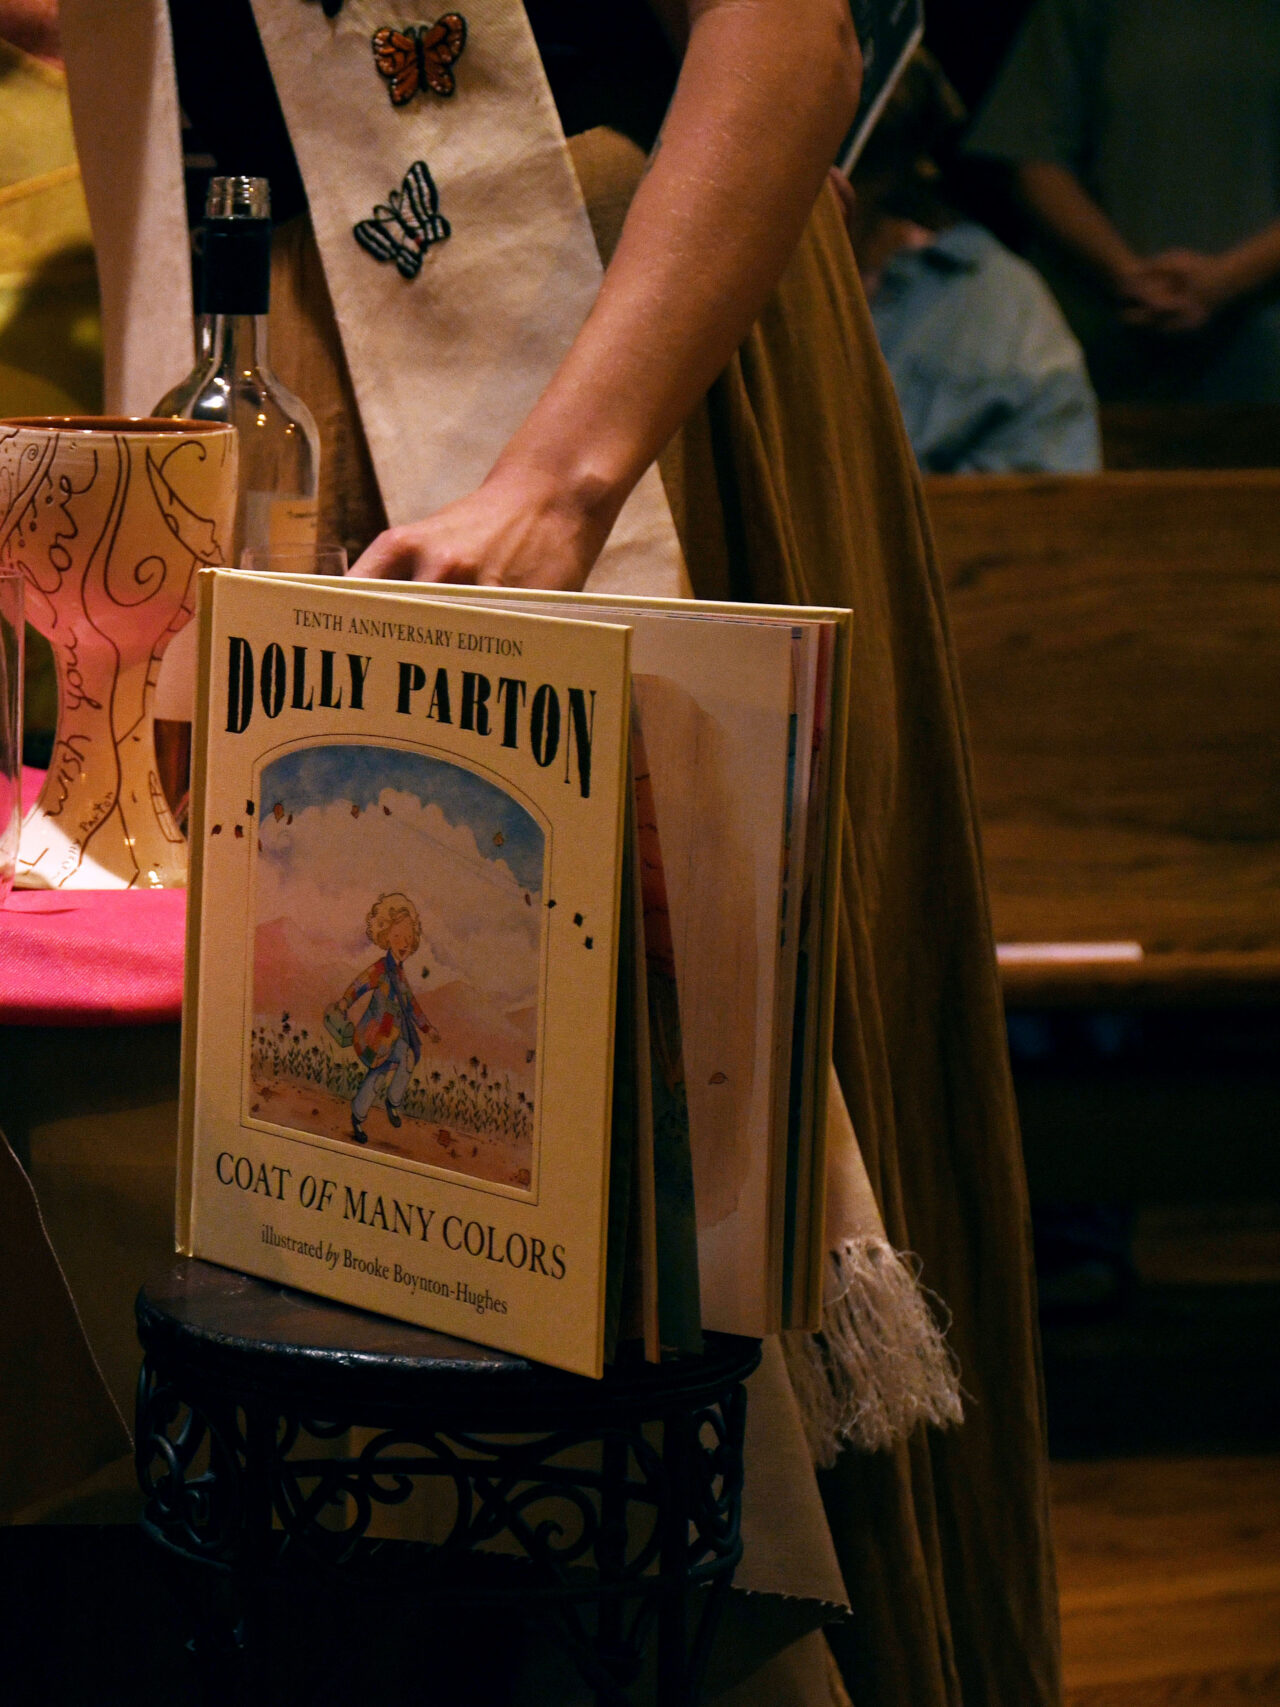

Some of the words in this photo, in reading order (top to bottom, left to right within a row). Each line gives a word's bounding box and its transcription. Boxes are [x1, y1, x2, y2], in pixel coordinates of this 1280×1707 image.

[17, 448, 99, 629] love
[66, 628, 102, 711] you
[293, 608, 343, 633] TENTH
[348, 620, 454, 648] ANNIVERSARY
[458, 633, 523, 657] EDITION
[225, 636, 372, 734] DOLLY
[396, 661, 597, 798] PARTON
[43, 734, 91, 817] wish
[216, 1152, 292, 1200] COAT
[300, 1175, 337, 1211] OF
[342, 1187, 435, 1242] MANY
[443, 1215, 567, 1280] COLORS
[261, 1224, 322, 1259] illustrated
[325, 1243, 340, 1270] by
[344, 1249, 390, 1280] Brooke
[394, 1264, 508, 1315] Boynton-Hughes
